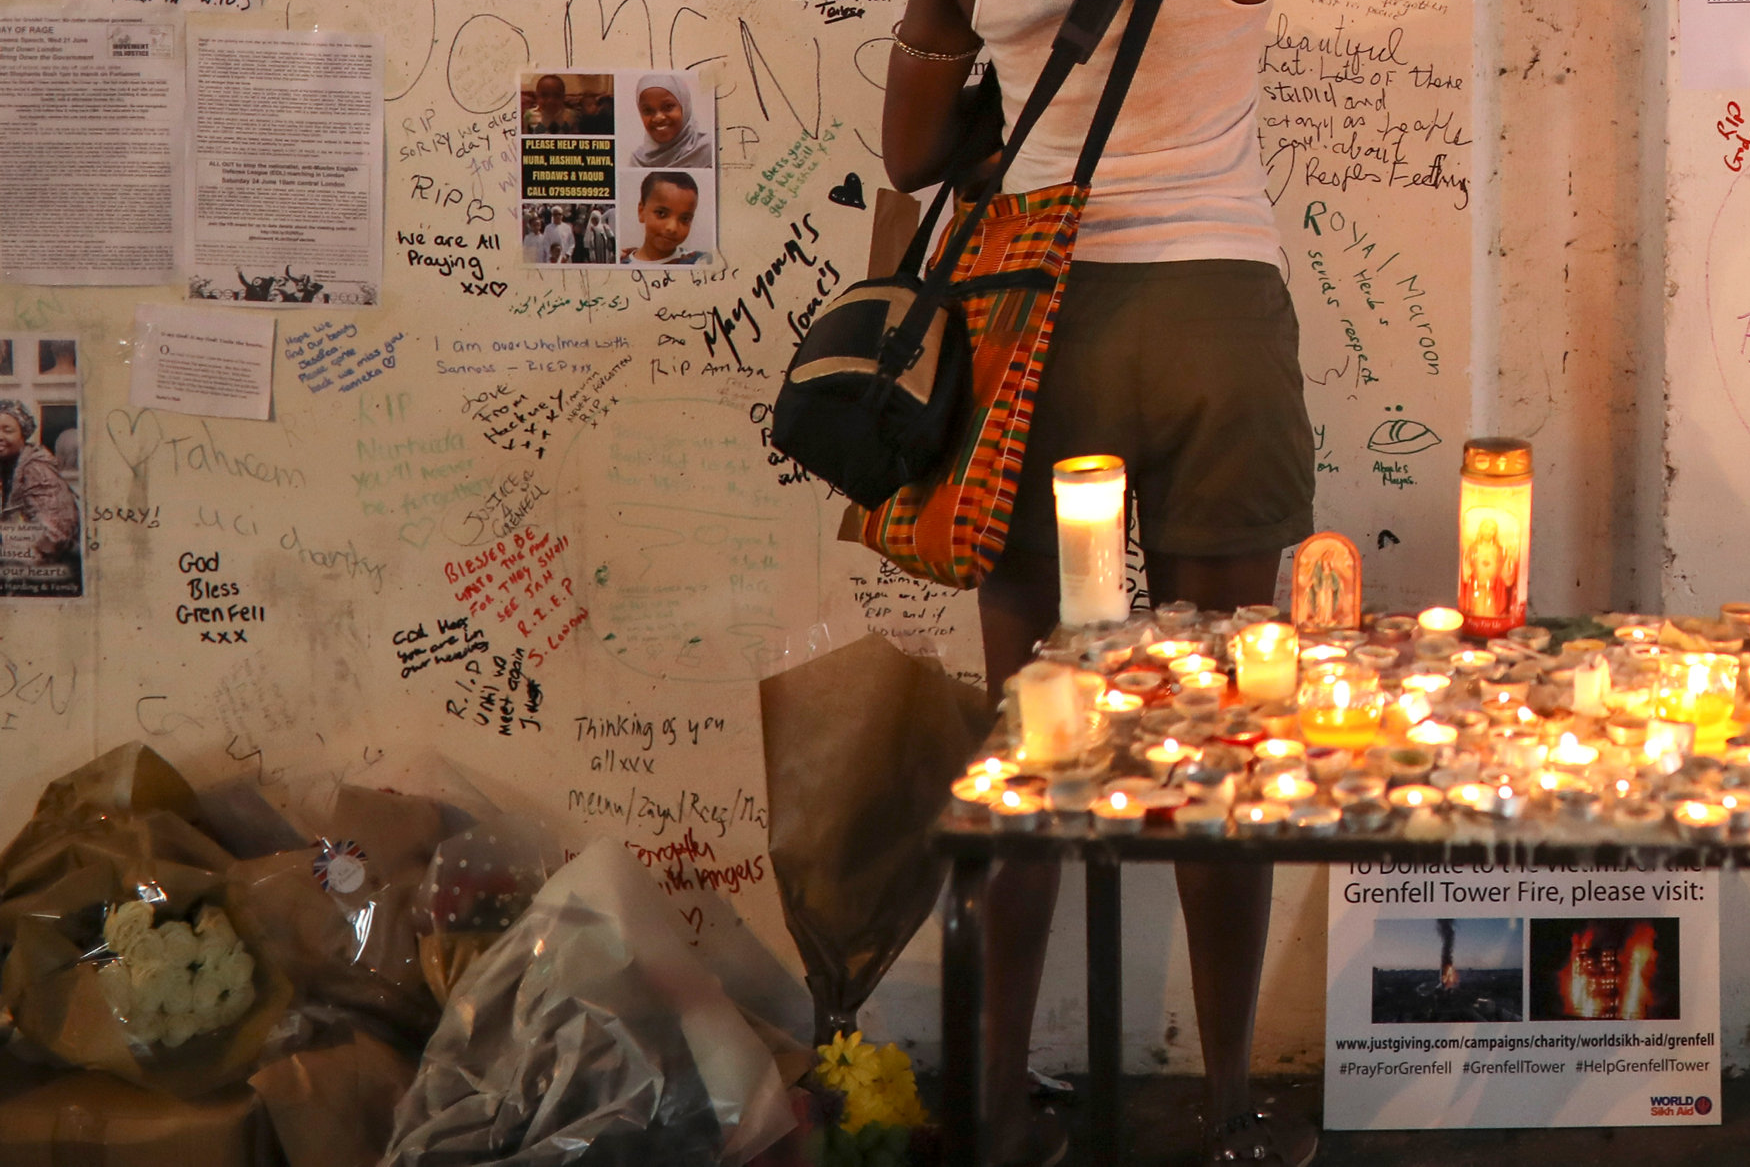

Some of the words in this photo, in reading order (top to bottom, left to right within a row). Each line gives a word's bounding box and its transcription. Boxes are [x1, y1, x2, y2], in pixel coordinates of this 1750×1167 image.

[179, 551, 219, 573] God
[187, 578, 239, 600] Bless
[1344, 882, 1434, 904] Grenfell
[1441, 882, 1509, 903] Tower
[1518, 882, 1564, 905] Fire,
[1572, 882, 1645, 907] please
[1652, 881, 1704, 901] visit:
[1340, 1061, 1451, 1077] #PrayForGrenfell
[1463, 1060, 1565, 1075] #GrenfellTower
[1576, 1059, 1709, 1074] #HelpGrenfellTower
[1650, 1096, 1693, 1106] WORLD
[1650, 1106, 1673, 1116] Sikh
[1675, 1106, 1694, 1116] Aid
